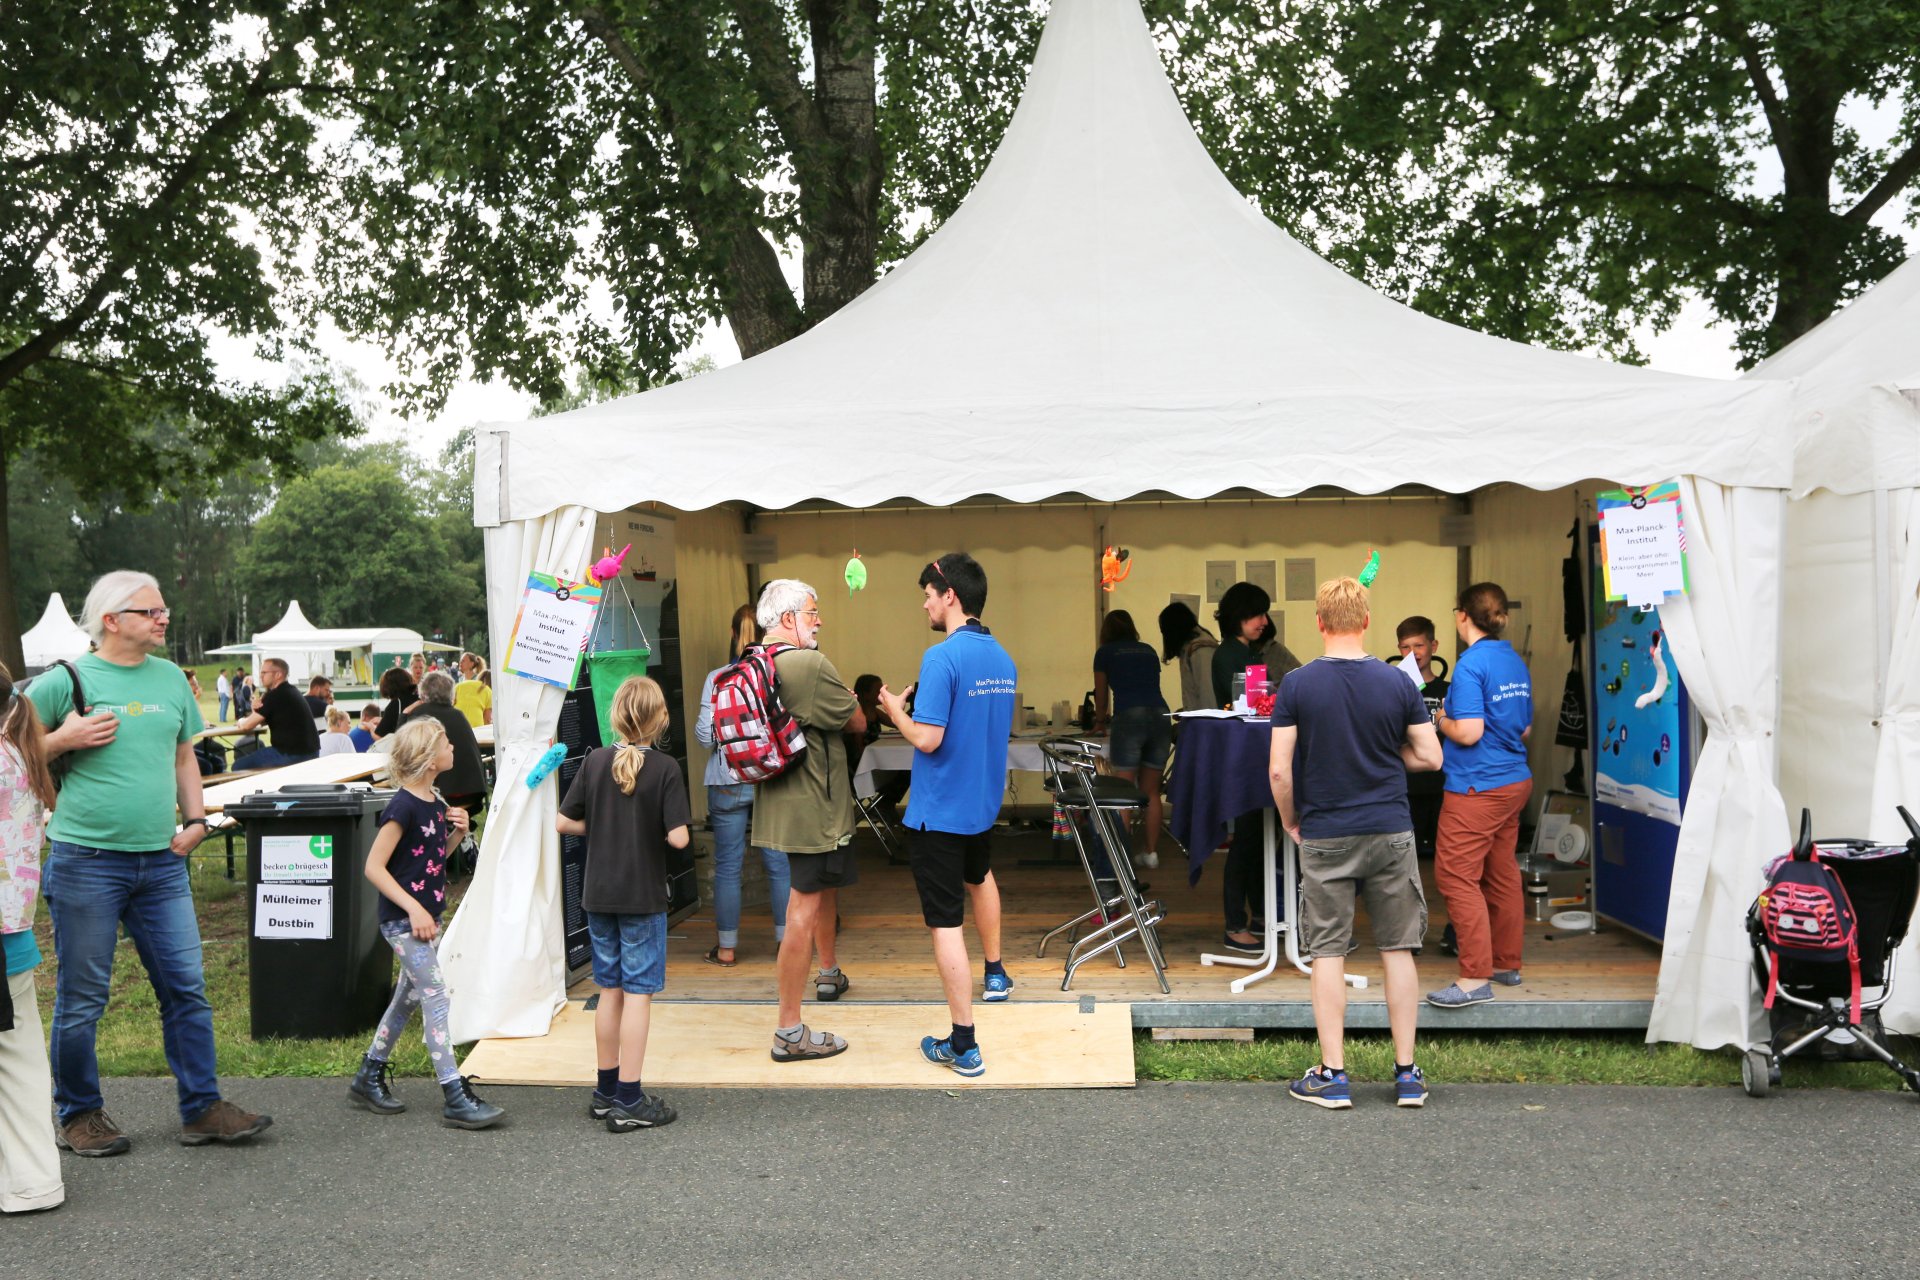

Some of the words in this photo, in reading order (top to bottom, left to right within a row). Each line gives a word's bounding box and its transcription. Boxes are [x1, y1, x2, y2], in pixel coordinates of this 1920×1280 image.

[1627, 536, 1657, 545] Institut
[538, 622, 565, 634] Institut
[535, 655, 551, 664] Meer
[263, 863, 287, 871] becker
[262, 894, 322, 906] Mülleimer
[268, 918, 314, 929] Dustbin
